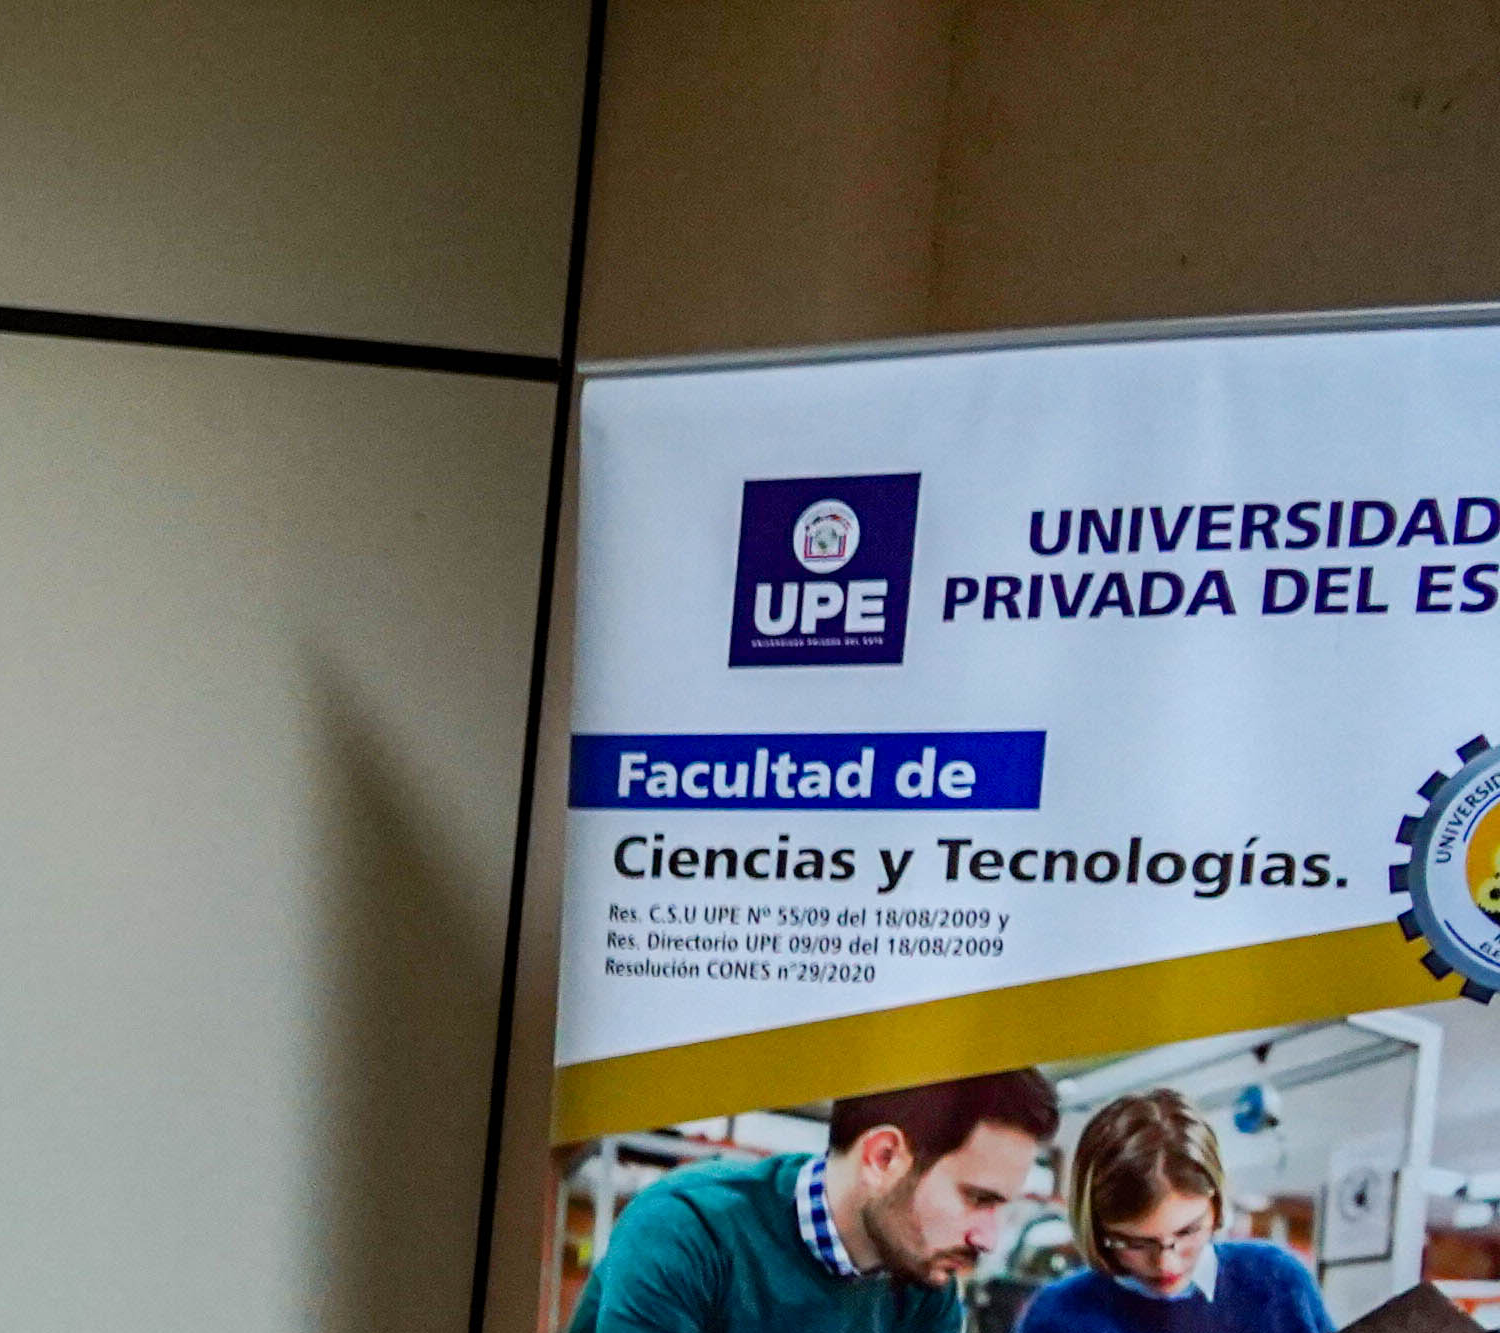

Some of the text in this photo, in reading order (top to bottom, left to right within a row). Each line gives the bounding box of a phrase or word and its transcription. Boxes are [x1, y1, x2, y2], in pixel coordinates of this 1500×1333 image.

[1030, 496, 1500, 557] UNIVERSIDAD
[753, 578, 889, 637] UPE
[943, 563, 1500, 623] PRIVADA DEL ES
[616, 747, 977, 800] Facultad de
[1435, 772, 1500, 865] UNIVERSID
[613, 834, 1349, 899] Ciencias y Tecnologías.
[607, 931, 1003, 956] Res. Directorio UPE 09/09 del 18/08/2009
[609, 904, 642, 924] Res.
[704, 906, 739, 925] UPE
[778, 907, 830, 927] 55/09
[837, 908, 866, 927] del
[876, 909, 990, 928] 18/08/2009
[999, 914, 1009, 933] y
[605, 957, 699, 978] Resolución
[707, 961, 770, 980] CONES
